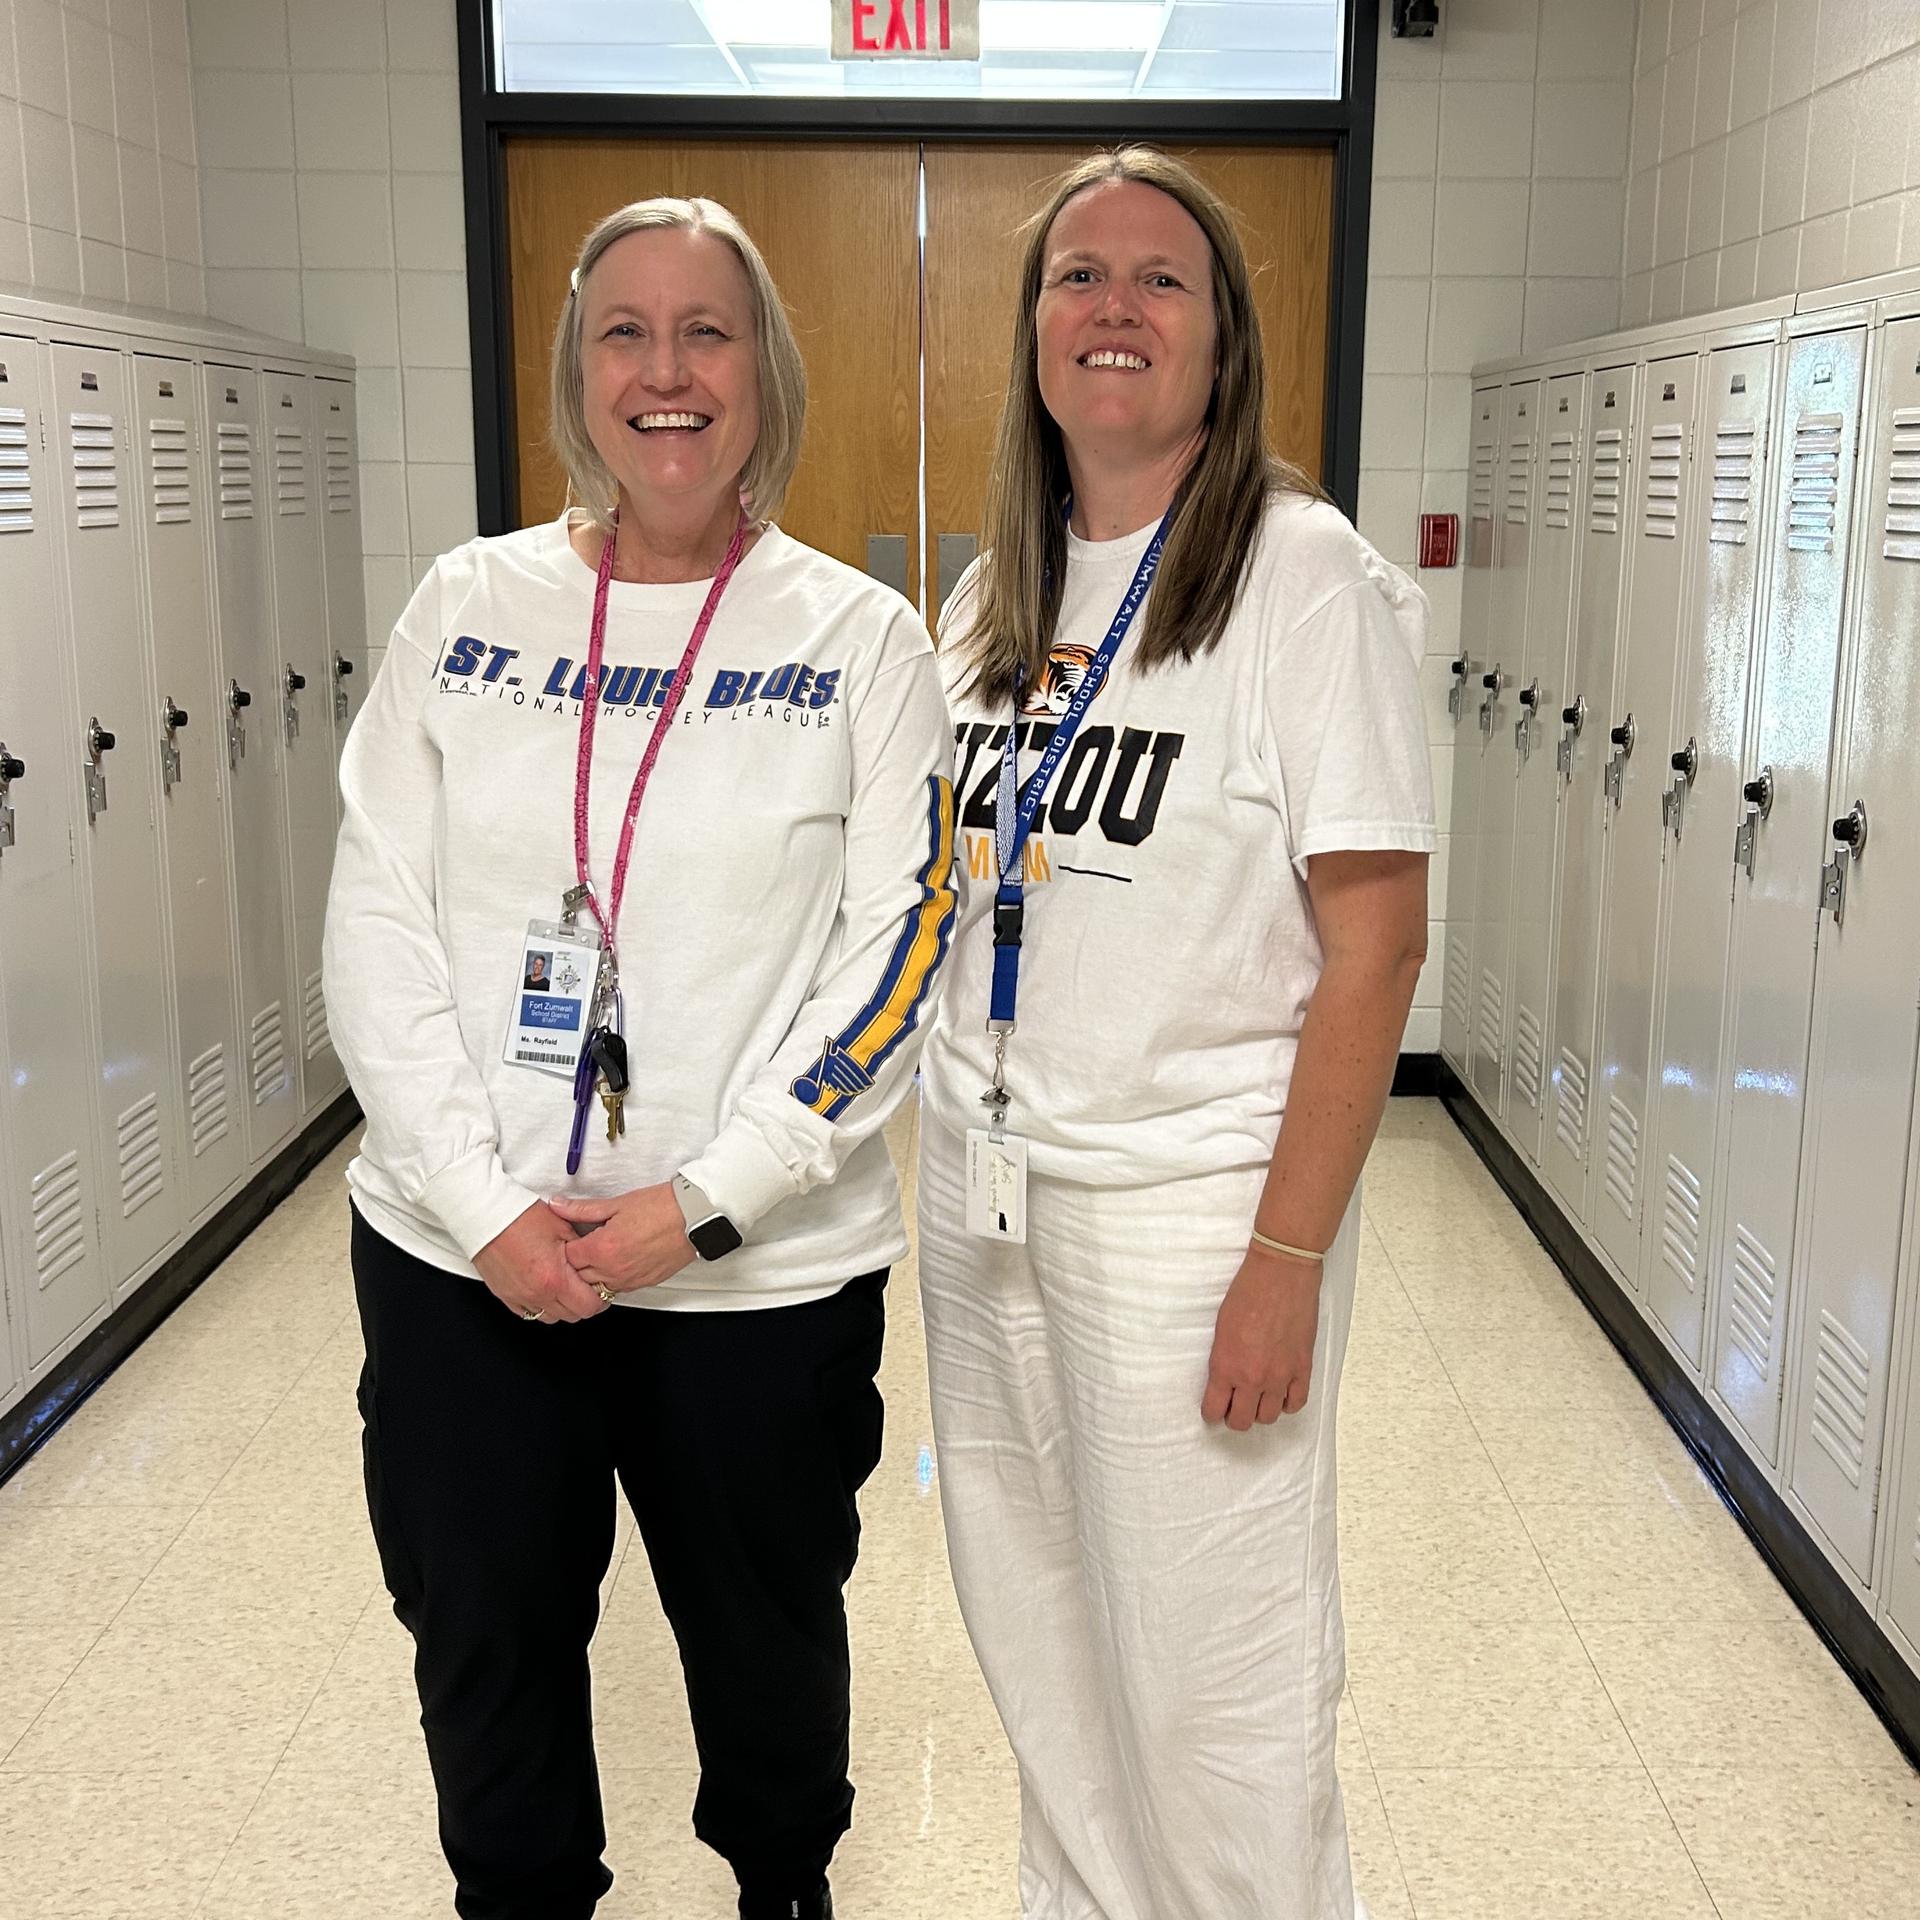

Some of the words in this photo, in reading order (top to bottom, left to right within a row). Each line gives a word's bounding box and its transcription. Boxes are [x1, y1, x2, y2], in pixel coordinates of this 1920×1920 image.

[1110, 538, 1163, 639] ZUMWALT
[439, 676, 581, 716] NATIONAL
[604, 706, 712, 724] HOCEY
[731, 704, 825, 728] LEAGUE
[443, 635, 522, 683] ST.
[543, 656, 693, 708] LOUIS
[704, 662, 841, 709] BLUES
[1066, 652, 1109, 721] SCHOOL
[1021, 735, 1066, 821] DISTRICT
[965, 834, 1051, 882] MM
[529, 1000, 543, 1010] Fort
[544, 1002, 573, 1013] Zumwalt
[533, 1037, 558, 1045] Rayfield
